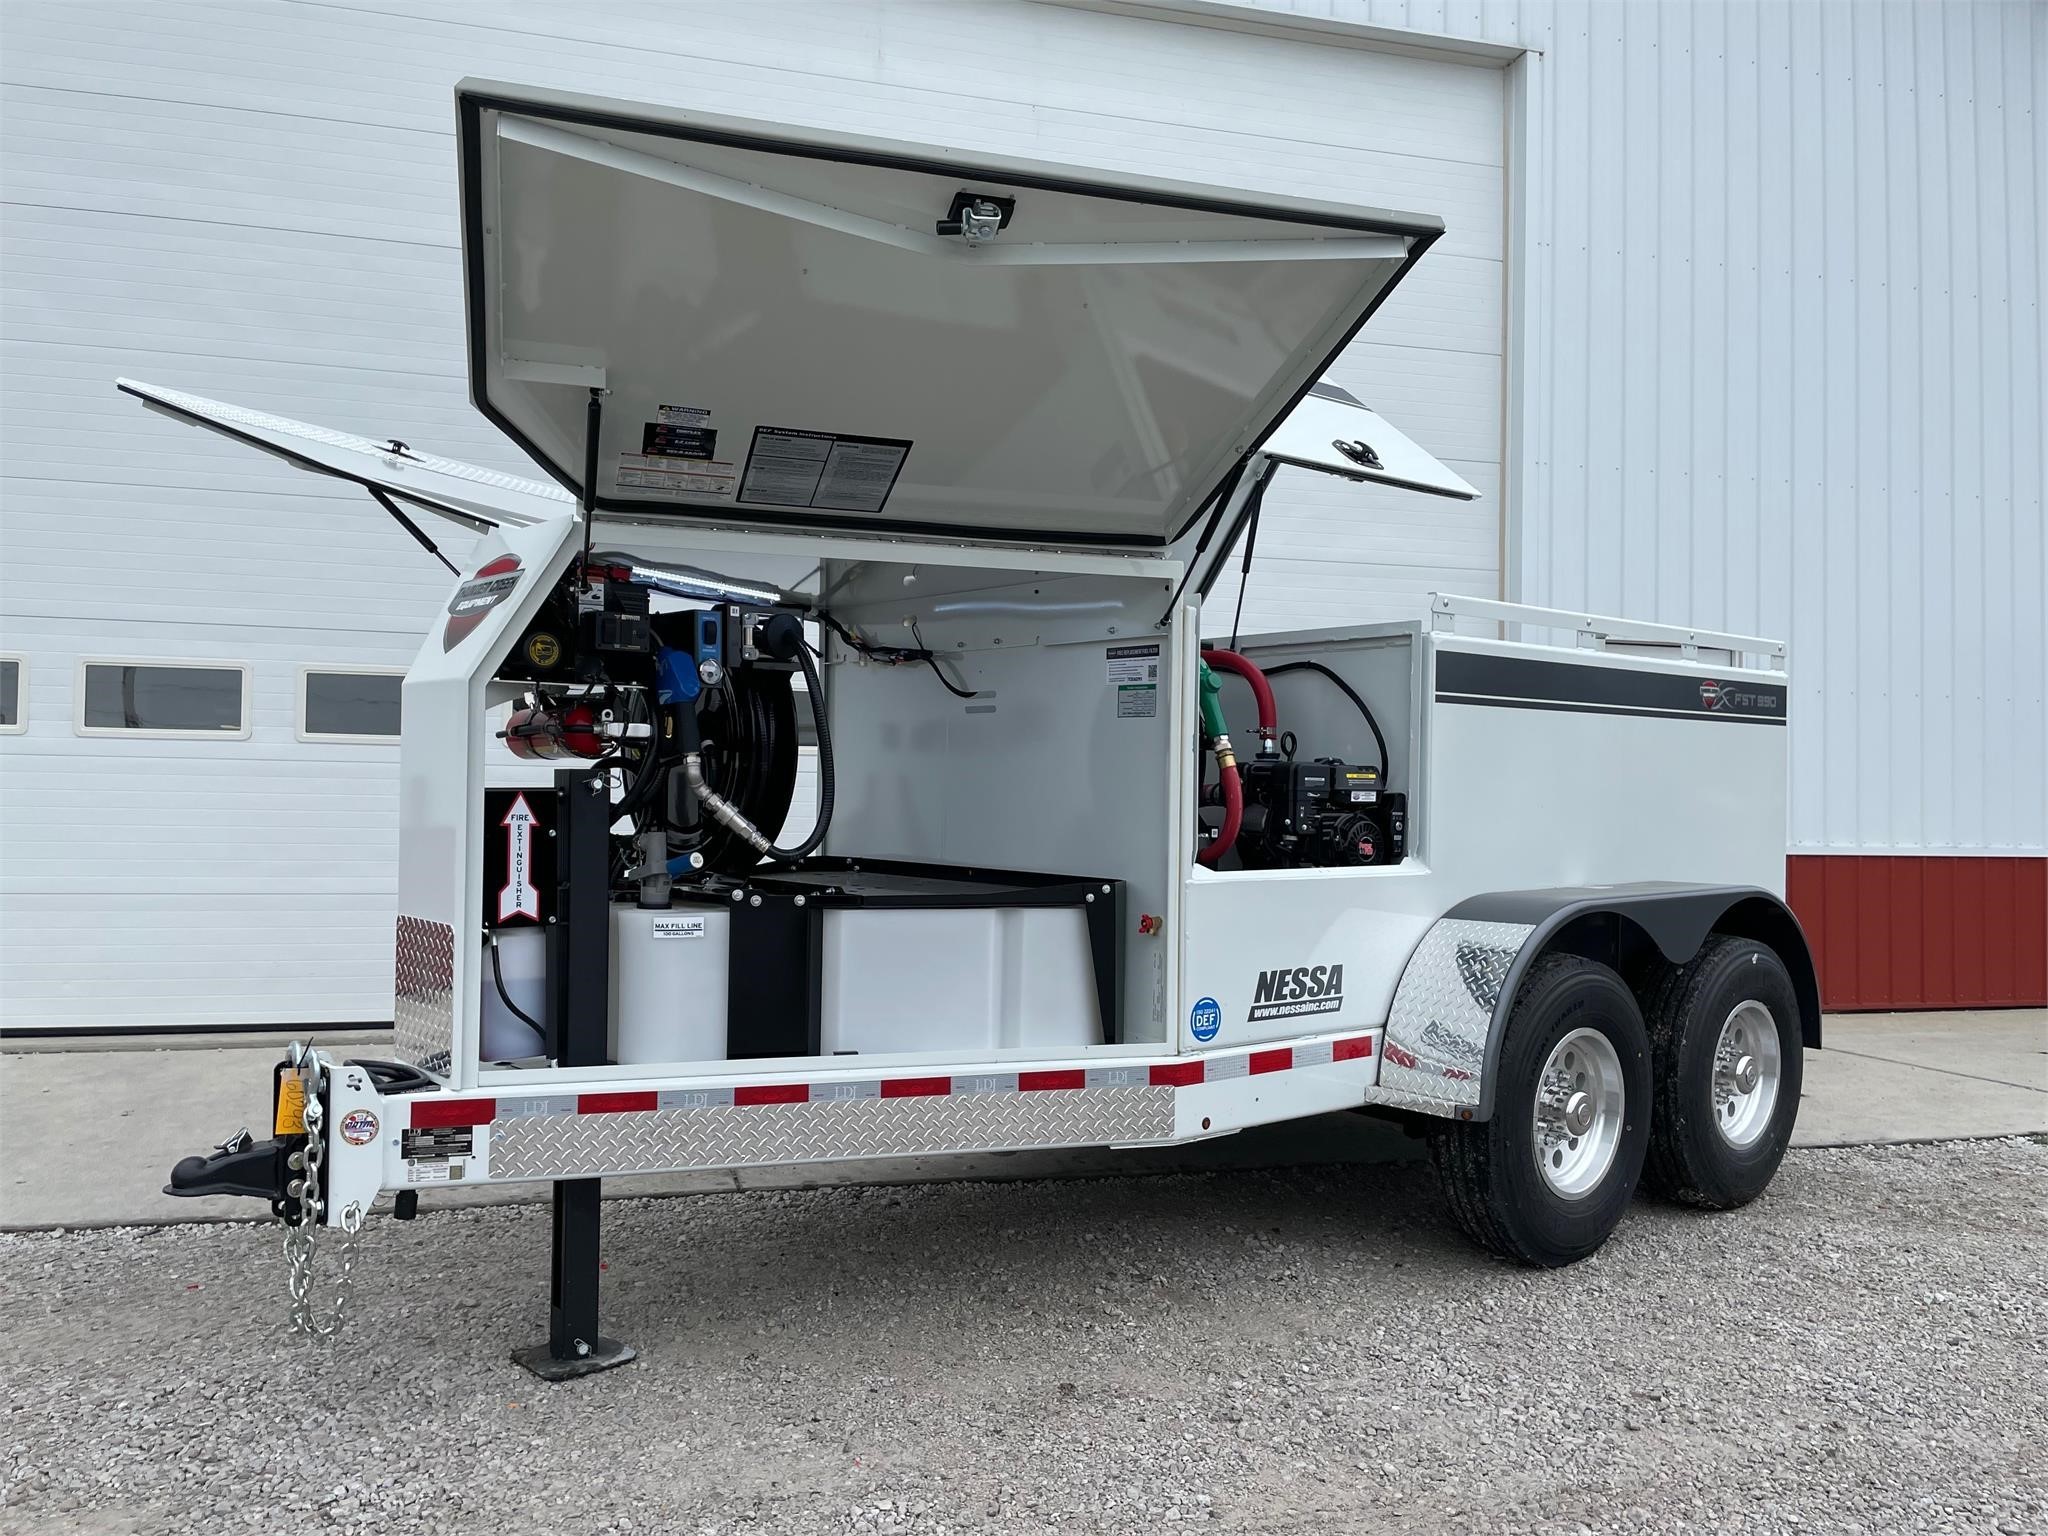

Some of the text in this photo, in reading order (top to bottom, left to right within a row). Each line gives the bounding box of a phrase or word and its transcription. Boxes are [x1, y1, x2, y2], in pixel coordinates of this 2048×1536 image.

[671, 406, 708, 415] WARNING
[774, 429, 798, 437] System
[1734, 693, 1756, 706] FST
[1253, 964, 1343, 1004] NESSA
[1253, 1000, 1340, 1019] www.nessainc.com
[1196, 1013, 1216, 1027] DEF
[1108, 1071, 1128, 1084] LDJ
[975, 1079, 997, 1092] LDJ
[835, 1086, 857, 1099] LDJ
[524, 1100, 549, 1114] LDJ
[684, 1093, 708, 1108] LDJ
